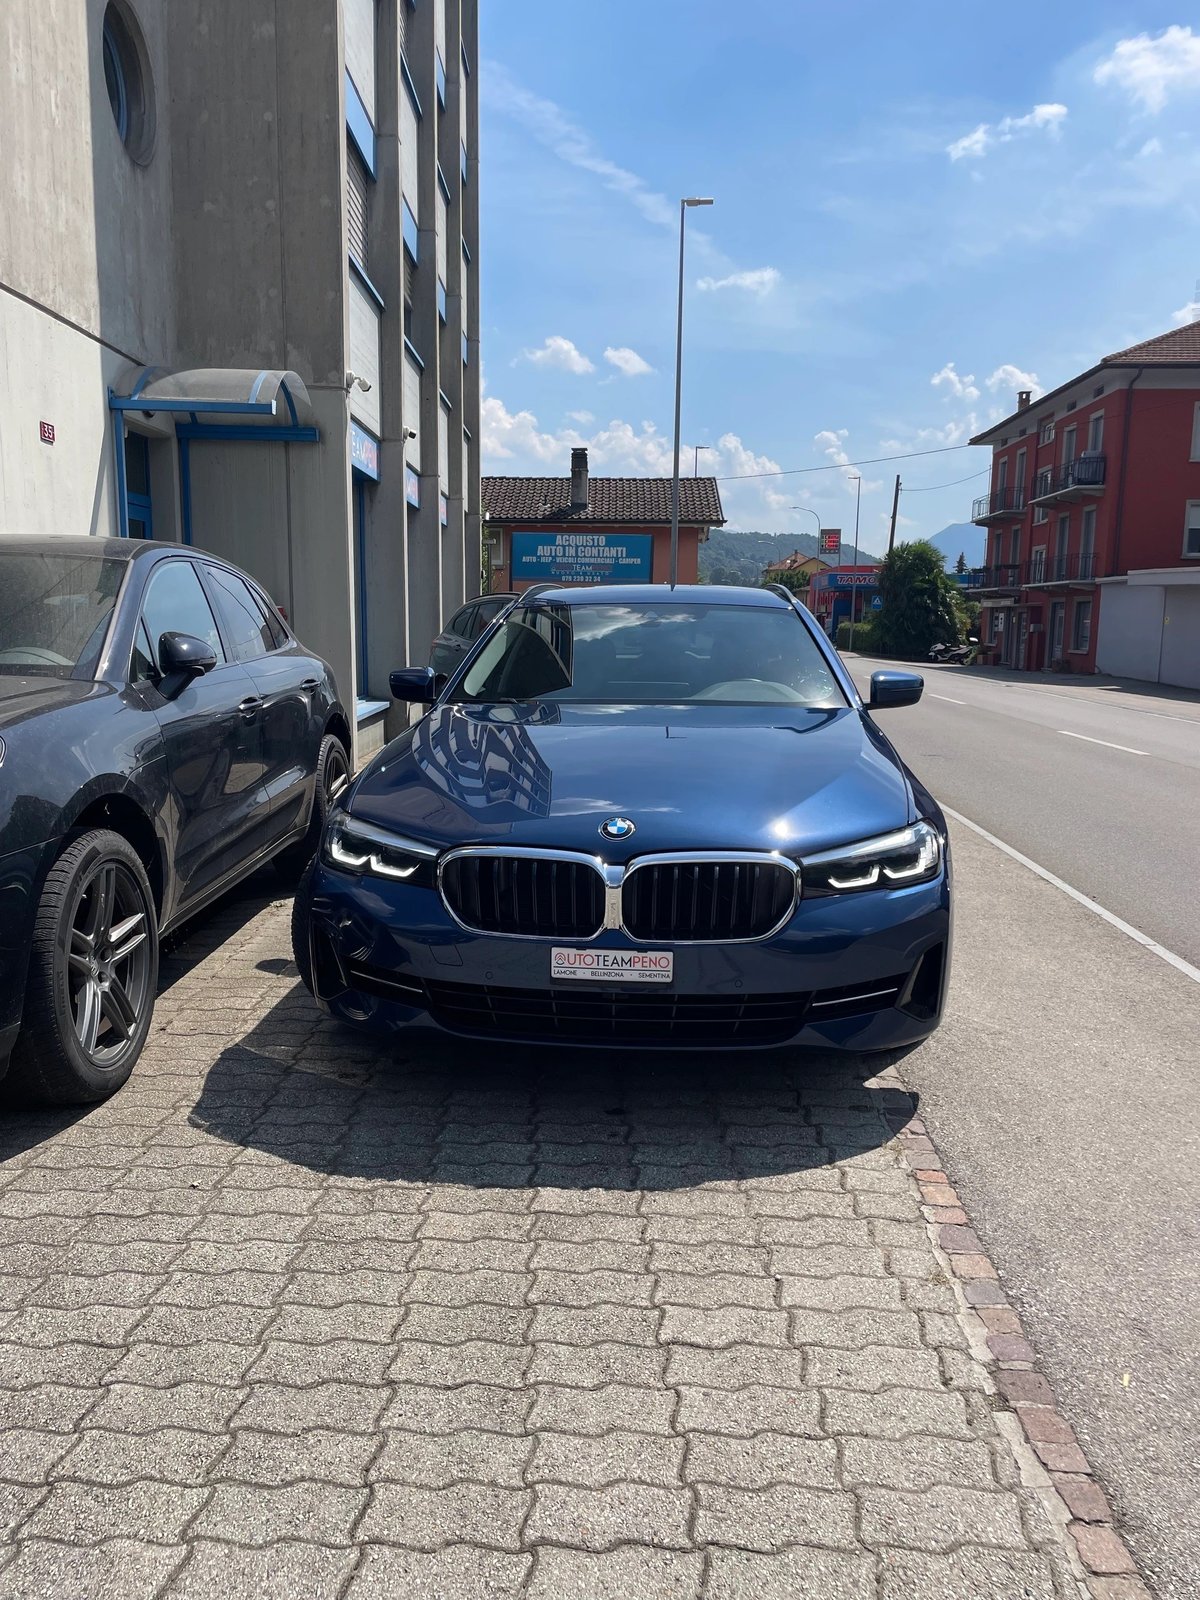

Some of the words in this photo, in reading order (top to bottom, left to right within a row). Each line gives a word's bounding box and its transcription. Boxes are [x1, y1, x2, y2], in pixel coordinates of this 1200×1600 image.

[43, 424, 53, 438] 35
[555, 535, 606, 547] ACQUISTO
[537, 545, 563, 556] AUTO
[565, 546, 576, 557] IN
[577, 546, 627, 558] CONTANTI
[837, 575, 878, 585] TAMO
